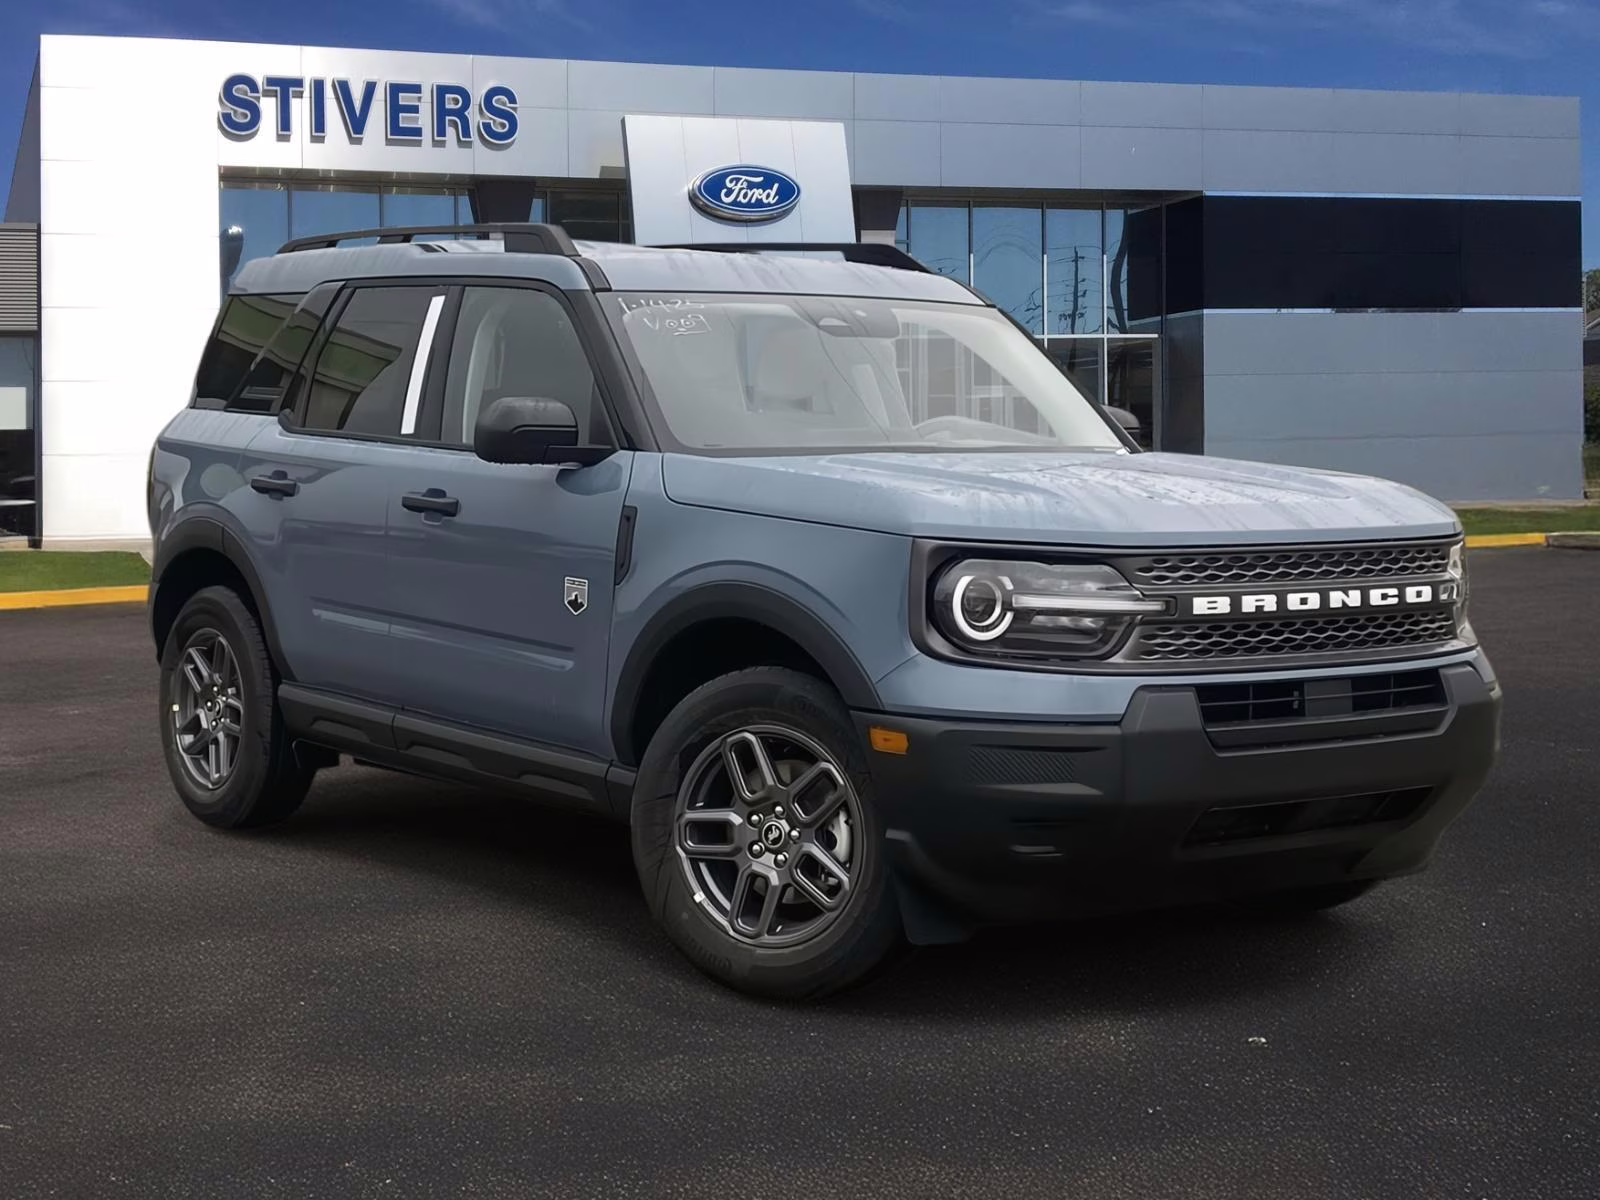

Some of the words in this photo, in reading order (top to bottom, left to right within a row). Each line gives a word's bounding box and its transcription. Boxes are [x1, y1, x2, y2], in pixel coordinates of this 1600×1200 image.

[218, 73, 519, 147] STIVERS
[720, 174, 779, 204] Ford
[1192, 585, 1433, 615] BRONCO
